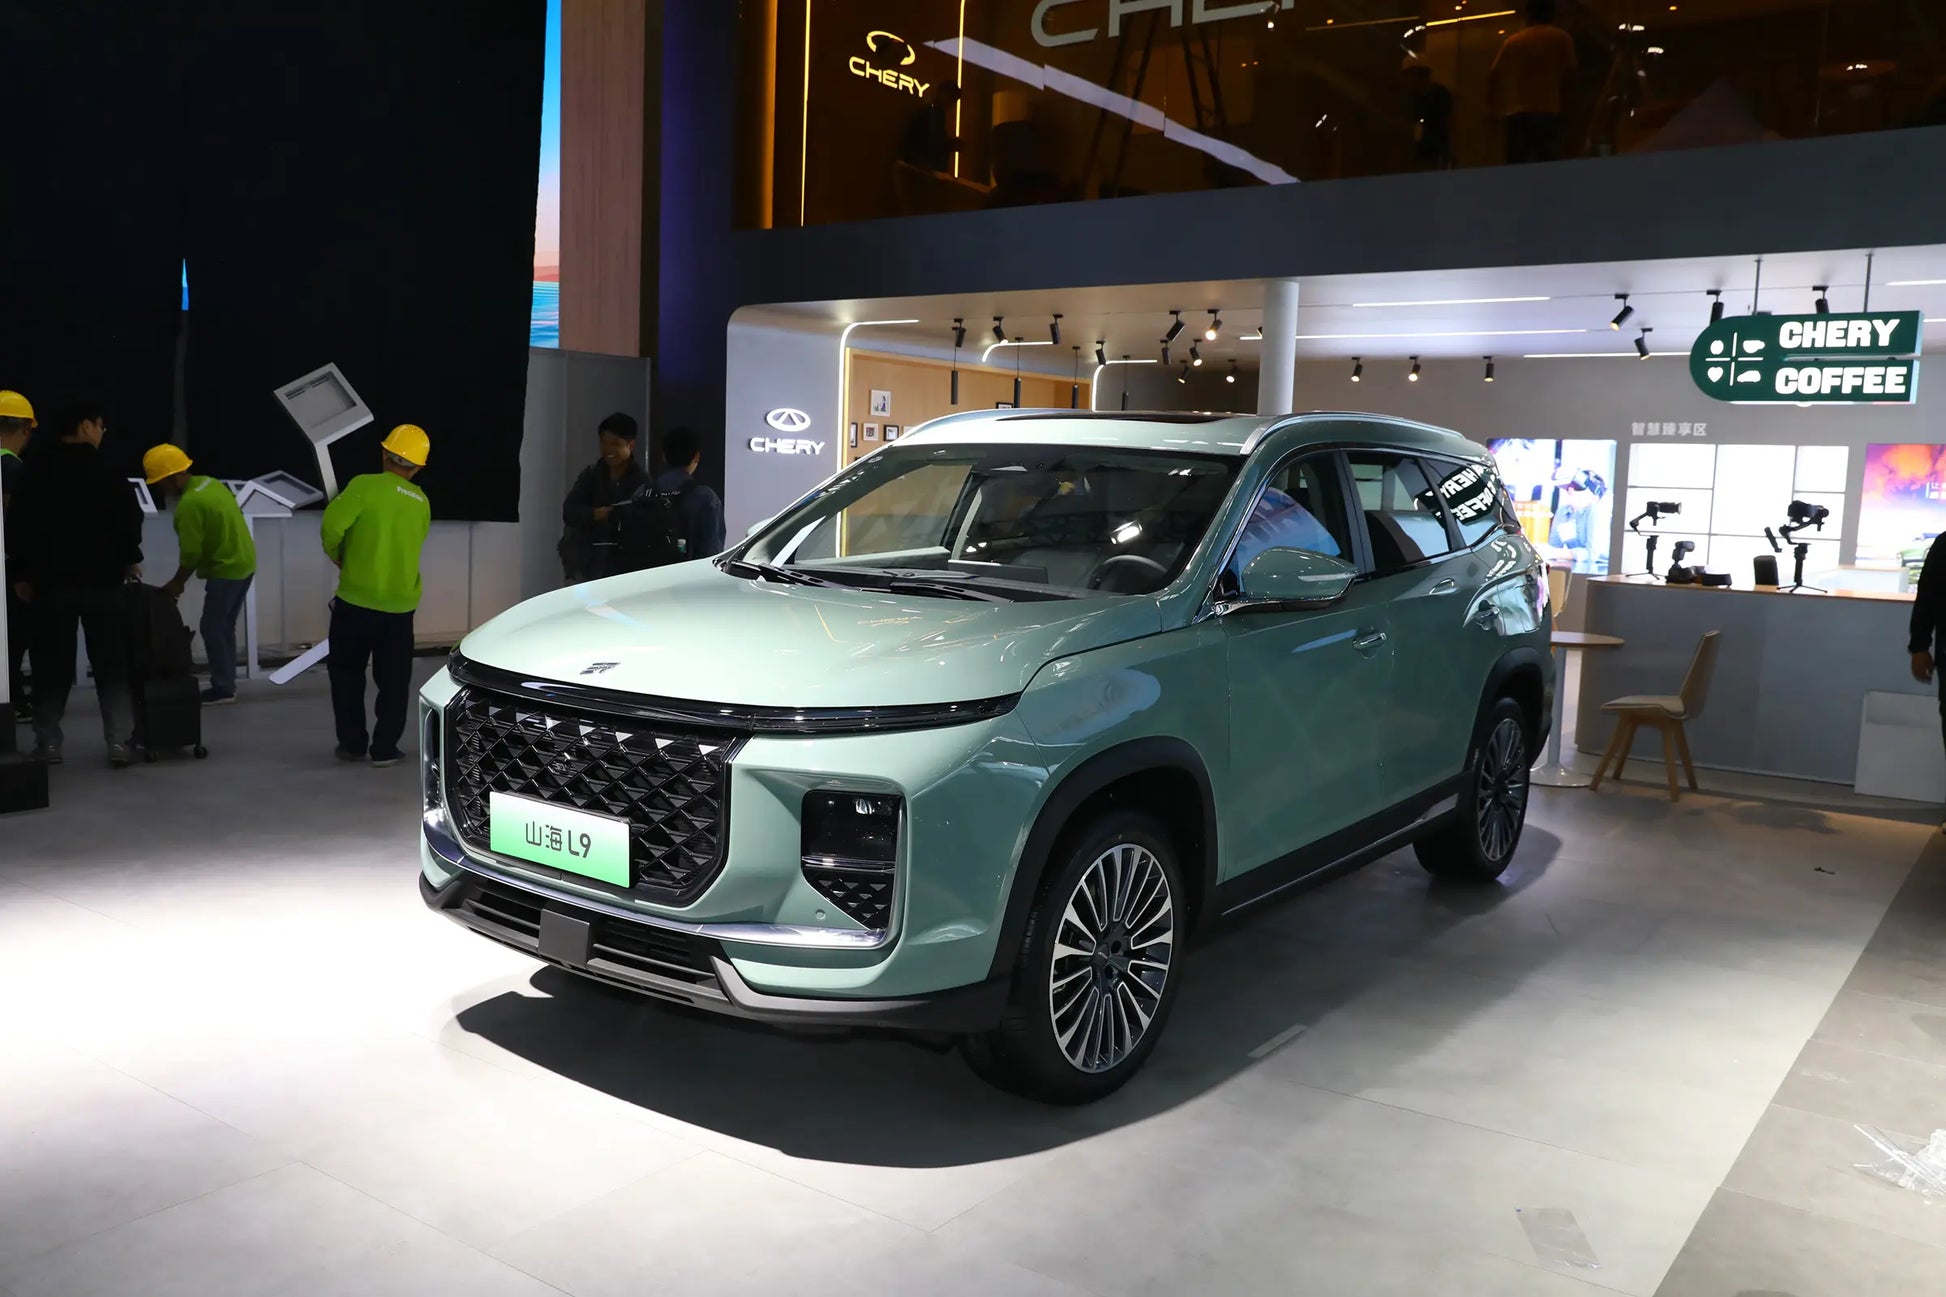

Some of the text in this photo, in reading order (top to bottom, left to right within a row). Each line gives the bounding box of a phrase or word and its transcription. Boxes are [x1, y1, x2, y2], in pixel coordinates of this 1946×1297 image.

[849, 56, 930, 98] CHERY
[1779, 318, 1900, 349] CHERY
[1775, 366, 1907, 394] COFFEE
[750, 437, 826, 456] CHERY
